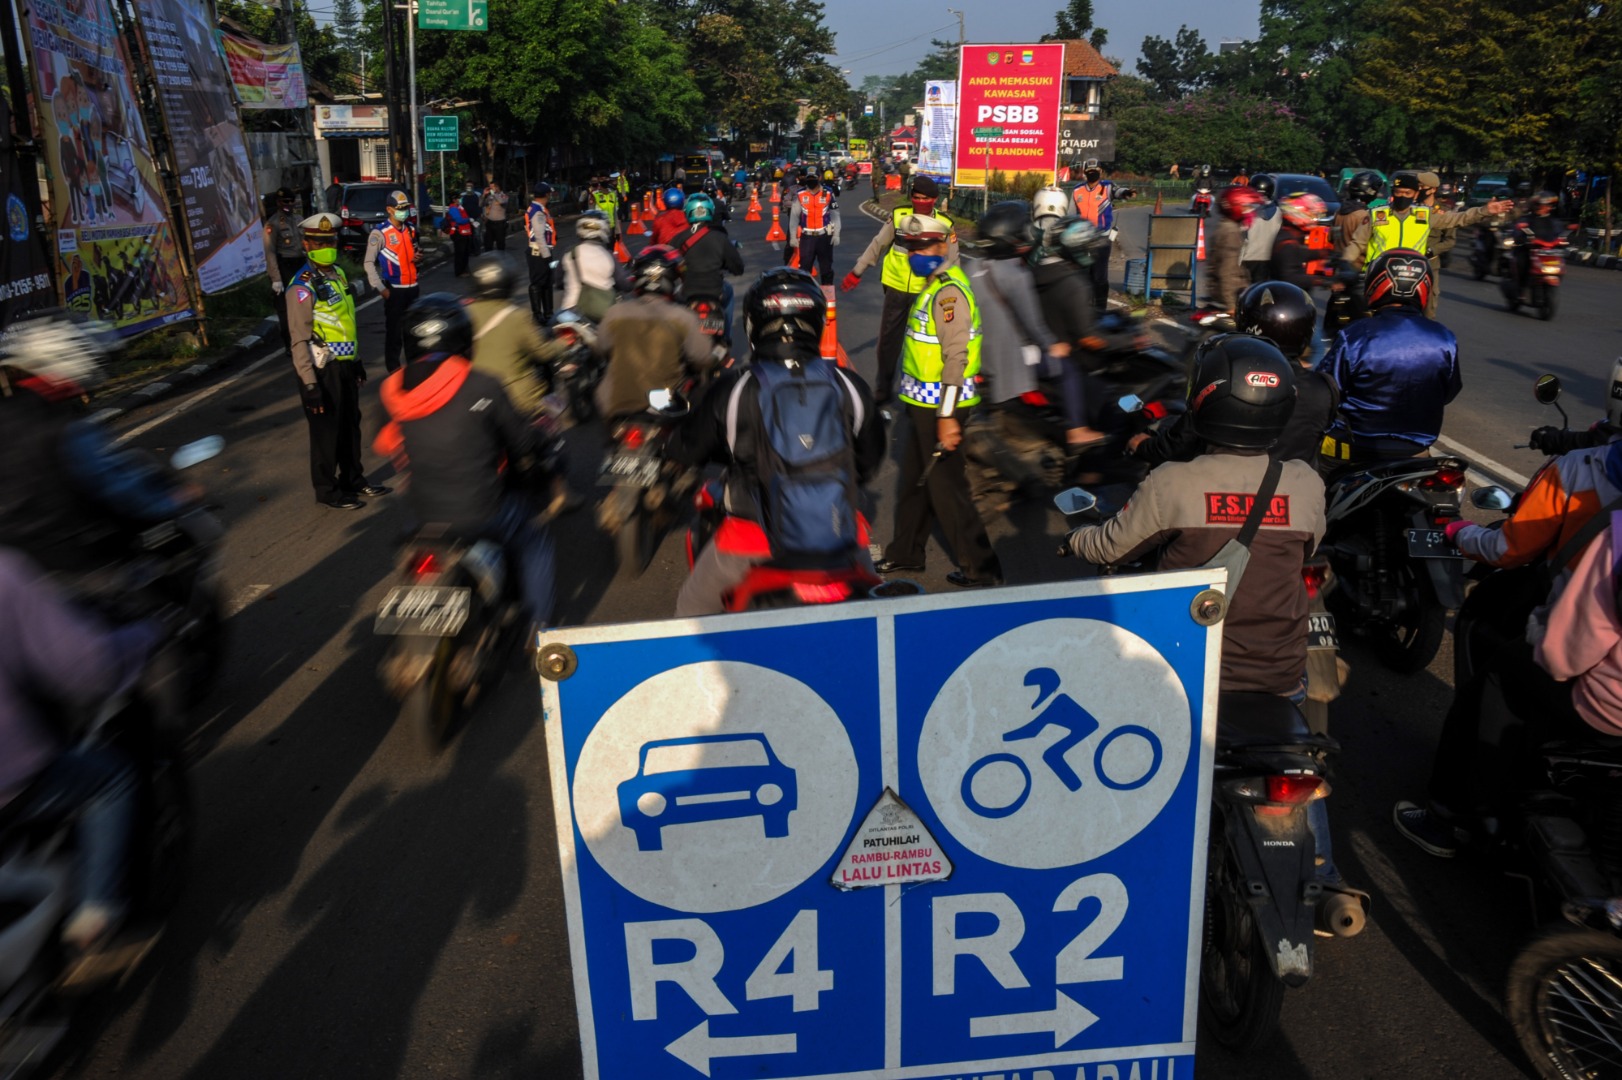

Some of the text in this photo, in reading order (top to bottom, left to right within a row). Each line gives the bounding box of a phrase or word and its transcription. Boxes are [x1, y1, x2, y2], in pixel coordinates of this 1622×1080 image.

[968, 77, 1053, 85] ANDA MEMASUKI
[984, 89, 1035, 98] KAWASAN
[977, 105, 1039, 123] PSBB
[1061, 139, 1099, 148] RTABAT
[968, 147, 1044, 156] KOTA BANDUNG
[1410, 531, 1417, 543] Z
[863, 834, 920, 848] PATUHILAH
[851, 848, 932, 864] RAMBU-RAMBU
[842, 861, 942, 882] LALU LINTAS
[624, 909, 834, 1021] R4
